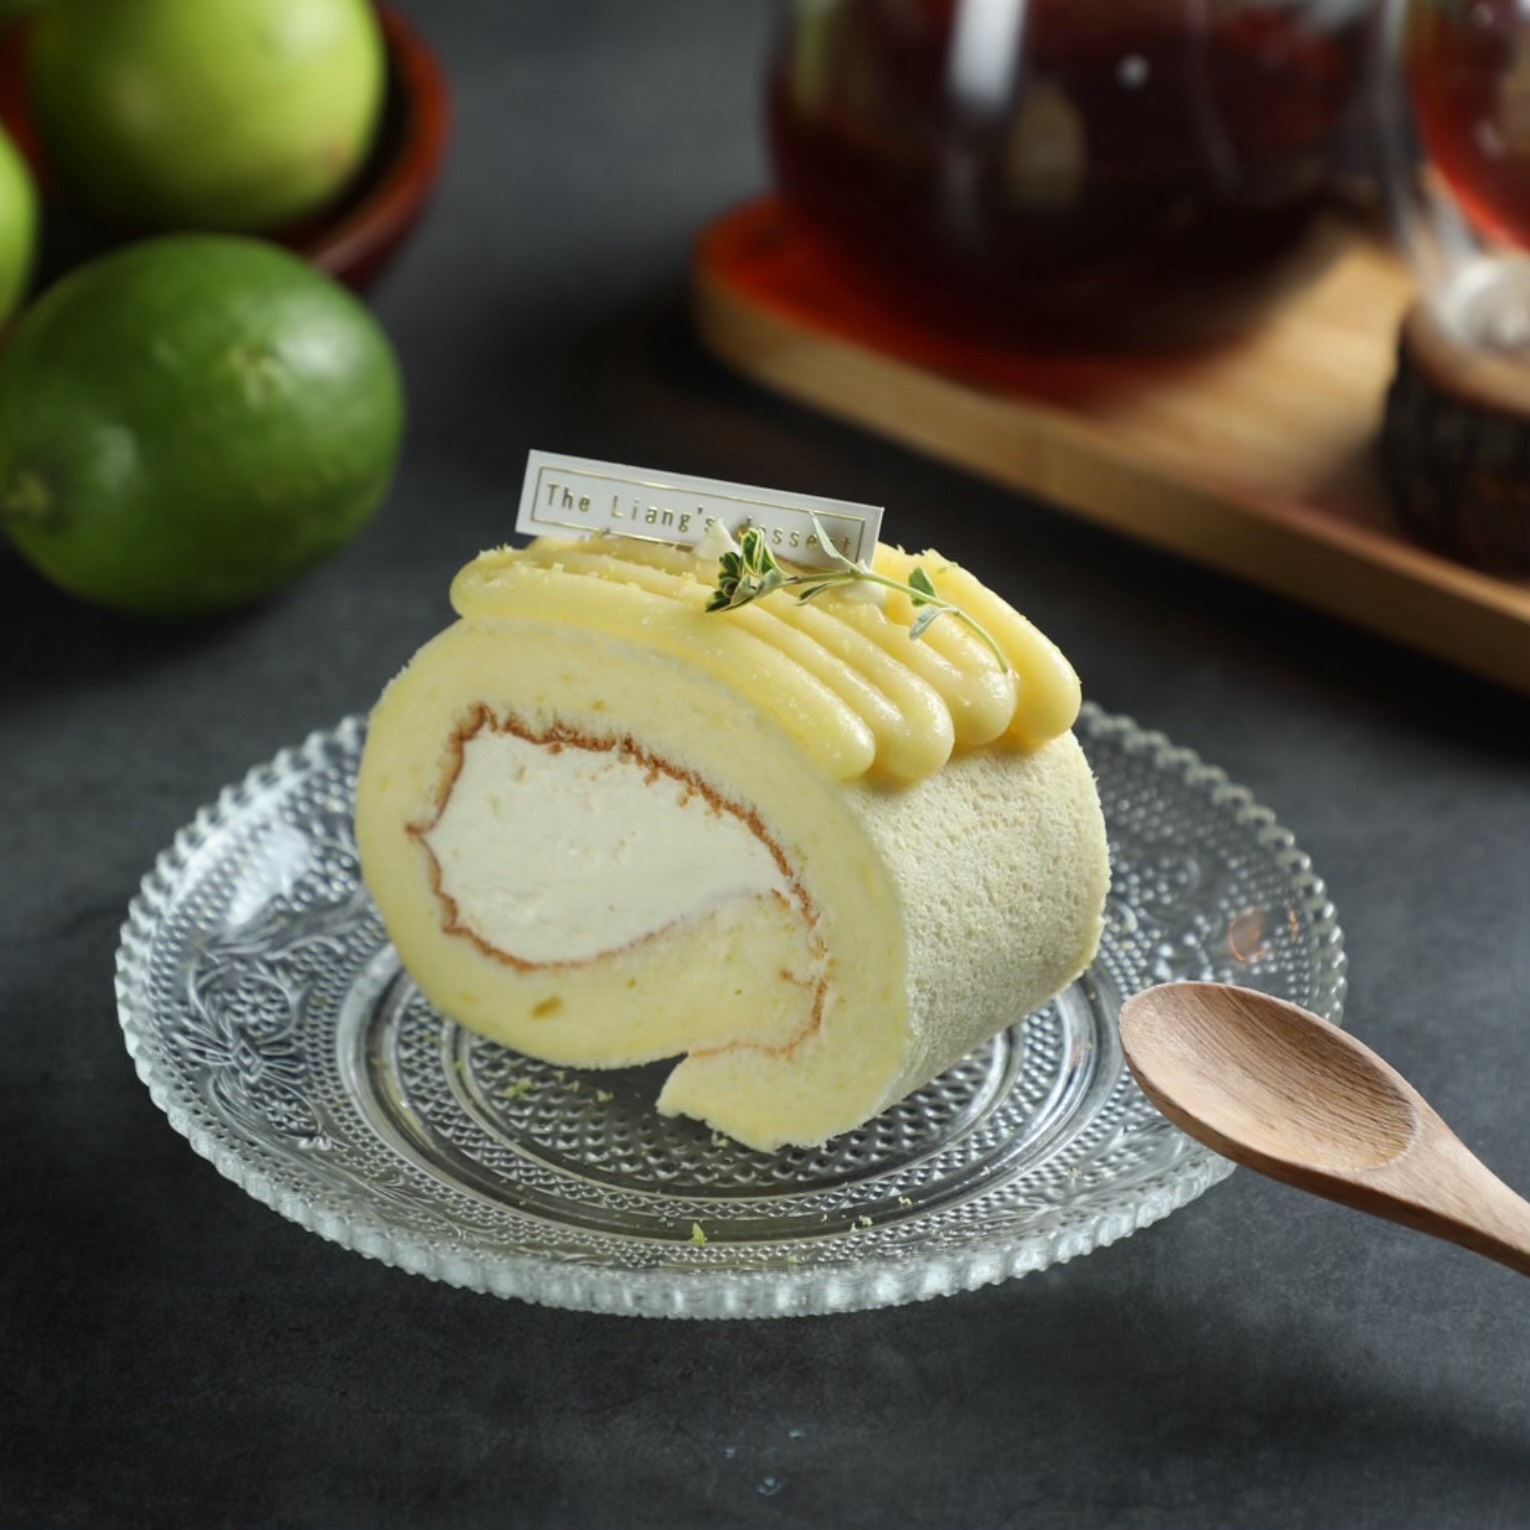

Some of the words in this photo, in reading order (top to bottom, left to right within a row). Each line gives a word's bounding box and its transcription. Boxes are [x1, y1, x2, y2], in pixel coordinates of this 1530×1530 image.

[545, 483, 592, 513] The
[612, 494, 717, 534] Liang's
[737, 516, 853, 557] dsset
